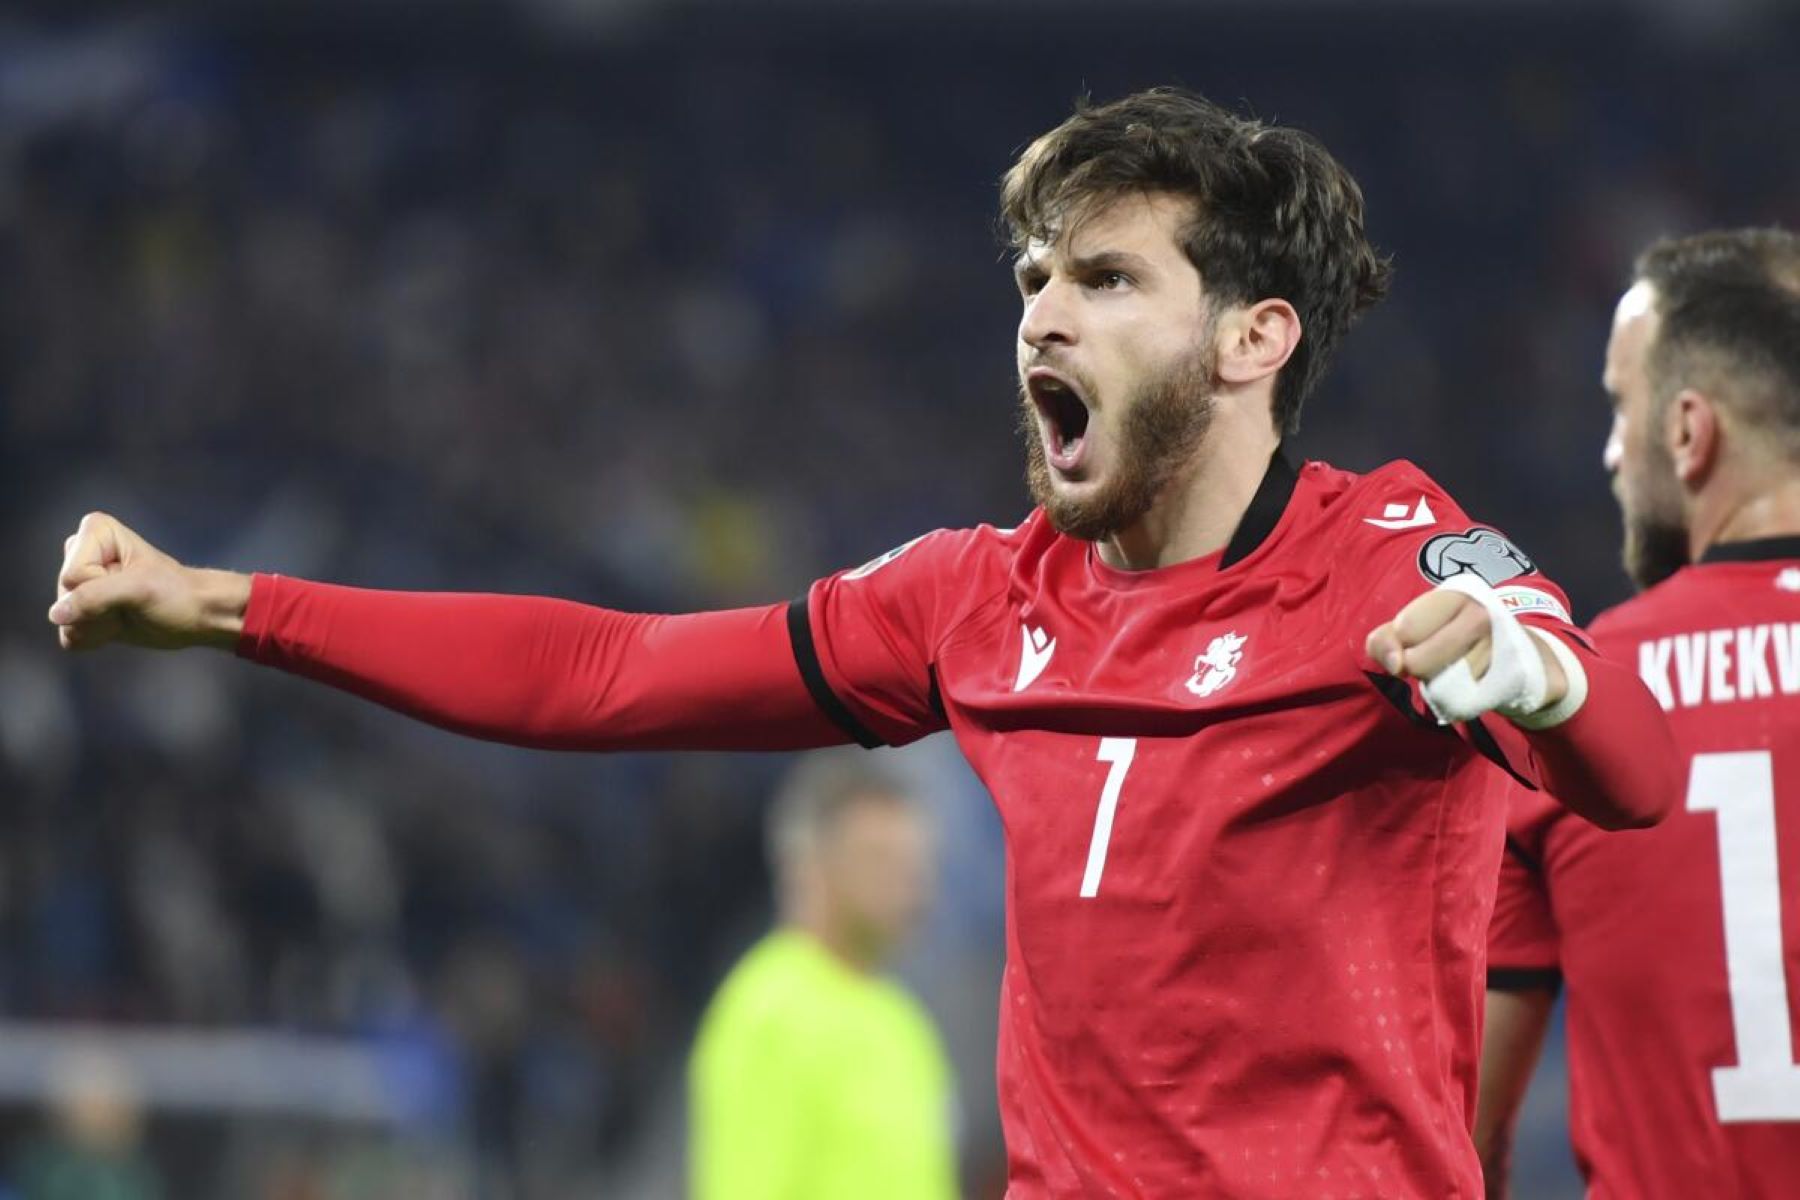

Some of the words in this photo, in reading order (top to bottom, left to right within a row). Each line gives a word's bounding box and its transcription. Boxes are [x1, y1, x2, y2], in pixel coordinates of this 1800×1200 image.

[1638, 622, 1800, 714] KVEKV
[1080, 737, 1138, 898] 7
[1686, 750, 1800, 1123] 1
